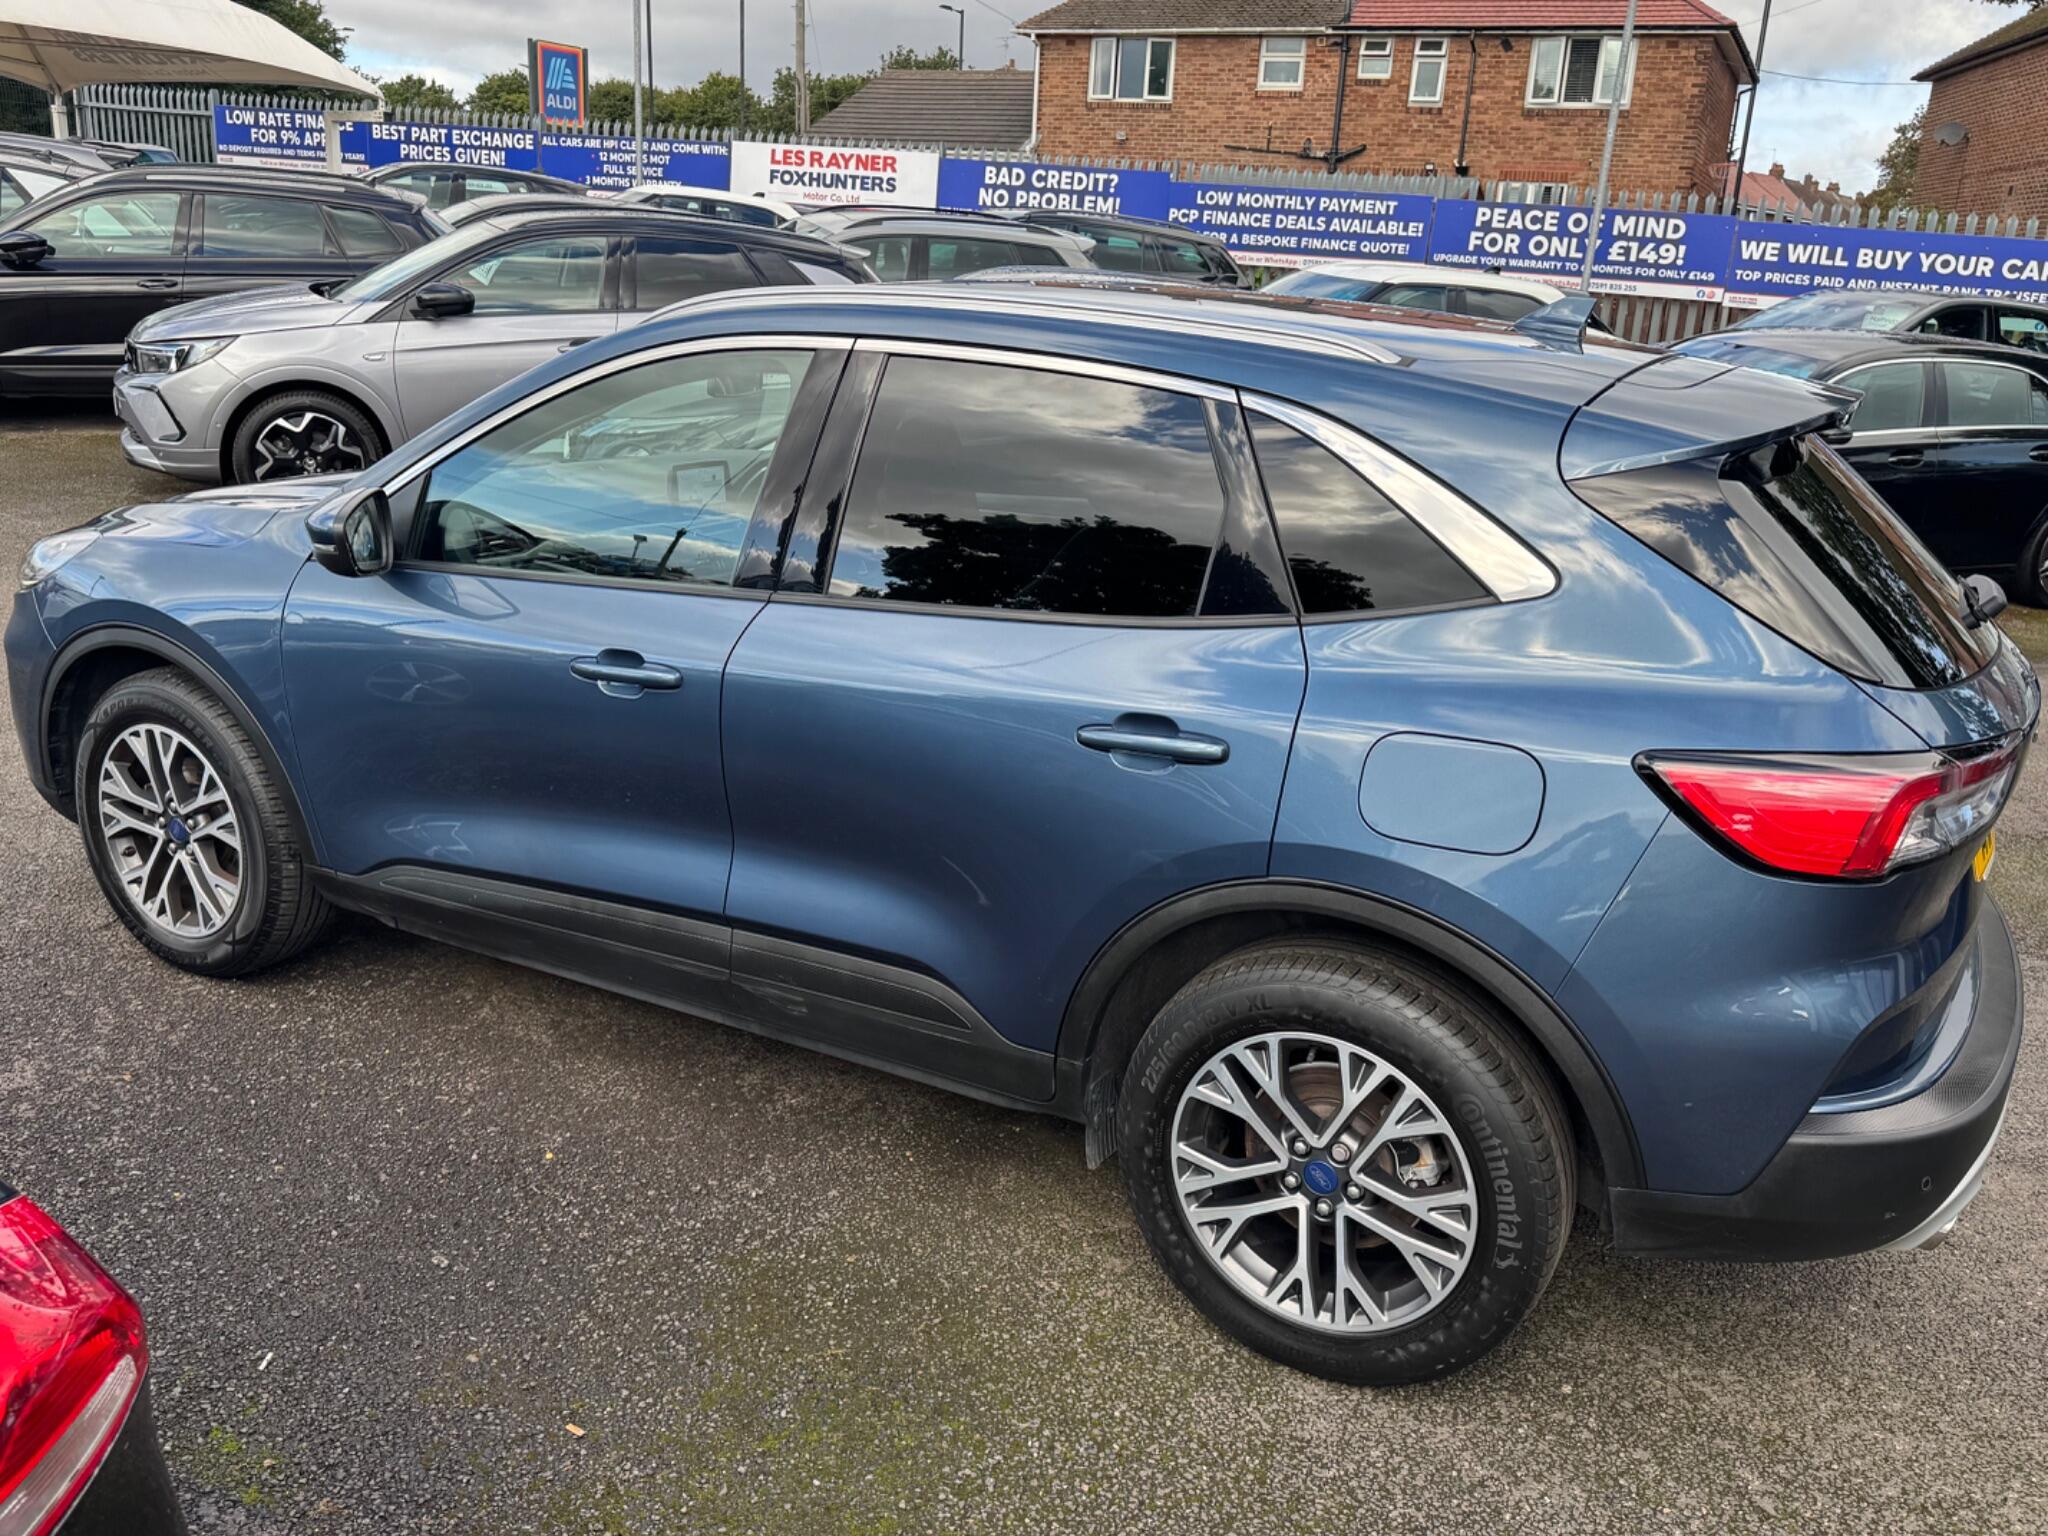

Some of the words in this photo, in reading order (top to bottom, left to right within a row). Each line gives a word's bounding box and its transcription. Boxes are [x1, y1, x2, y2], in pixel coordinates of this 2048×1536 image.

[546, 93, 576, 111] ALDI
[225, 110, 254, 124] LOW
[258, 112, 292, 128] RATE
[295, 113, 354, 131] FINAE
[250, 128, 277, 143] FOR
[280, 130, 300, 146] 9%
[372, 124, 406, 140] BEST
[411, 126, 448, 144] PART
[452, 130, 534, 150] EXCHANGE
[542, 138, 558, 146] ALL
[560, 138, 582, 148] CARS
[584, 139, 601, 149] ARE
[604, 140, 618, 150] HPI
[620, 141, 649, 152] CLER
[650, 142, 670, 153] AND
[672, 144, 699, 154] COME
[702, 146, 728, 156] WITH:
[229, 145, 252, 153] DEPOSIT
[283, 148, 296, 156] AND
[317, 150, 328, 158] FRO
[400, 144, 451, 162] PRICES
[455, 148, 506, 166] GIVEN!
[599, 152, 608, 161] 12
[610, 152, 648, 164] MONTS
[650, 155, 670, 165] MOT
[770, 148, 805, 166] LES
[809, 151, 898, 173] RAYNER
[585, 176, 590, 184] 3
[592, 177, 630, 188] MONTHS
[604, 165, 625, 175] FULL
[770, 169, 898, 193] FOXHUNTERS
[984, 166, 1026, 186] BAD
[1032, 169, 1120, 193] CREDIT?
[803, 192, 828, 202] Motor
[846, 195, 860, 204] Ltd
[978, 188, 1009, 208] NO
[1015, 191, 1120, 214] PROBLEM!
[1196, 190, 1233, 206] LOW
[1236, 192, 1316, 210] MONTHLY
[1320, 197, 1398, 215] PAYMENT
[1168, 208, 1199, 223] PCP
[1203, 210, 1272, 228] FINANCE
[1275, 214, 1326, 232] DEALS
[1329, 218, 1424, 238] AVAILABLE!
[1476, 207, 1560, 232] PEACE
[1612, 214, 1687, 240] MIND
[1230, 234, 1238, 244] A
[1242, 234, 1298, 248] BESPOKE
[1300, 237, 1357, 252] FINANCE
[1360, 241, 1410, 255] QUOTE!
[1468, 231, 1520, 254] FOR
[1608, 240, 1687, 266] £149!
[1433, 254, 1478, 264] UPGRADE
[1480, 256, 1506, 266] YOUR
[1508, 258, 1562, 270] WARRANTY
[1565, 262, 1579, 272] TO
[1591, 264, 1632, 276] MONTHS
[1634, 267, 1656, 278] FOR
[1658, 269, 1686, 280] ONLY
[1688, 270, 1715, 282] £149
[1740, 240, 1782, 262] WE
[1788, 243, 1848, 267] WILL
[1856, 248, 1912, 271] BUY
[1919, 252, 1994, 278] YOUR
[1735, 270, 1762, 282] TOP
[1764, 272, 1810, 286] PRICES
[1814, 276, 1844, 288] PAID
[1847, 278, 1878, 289] AND
[1880, 280, 1940, 292] INSTANT
[1943, 285, 1982, 296] BANK
[1455, 1093, 1524, 1250] Continental
